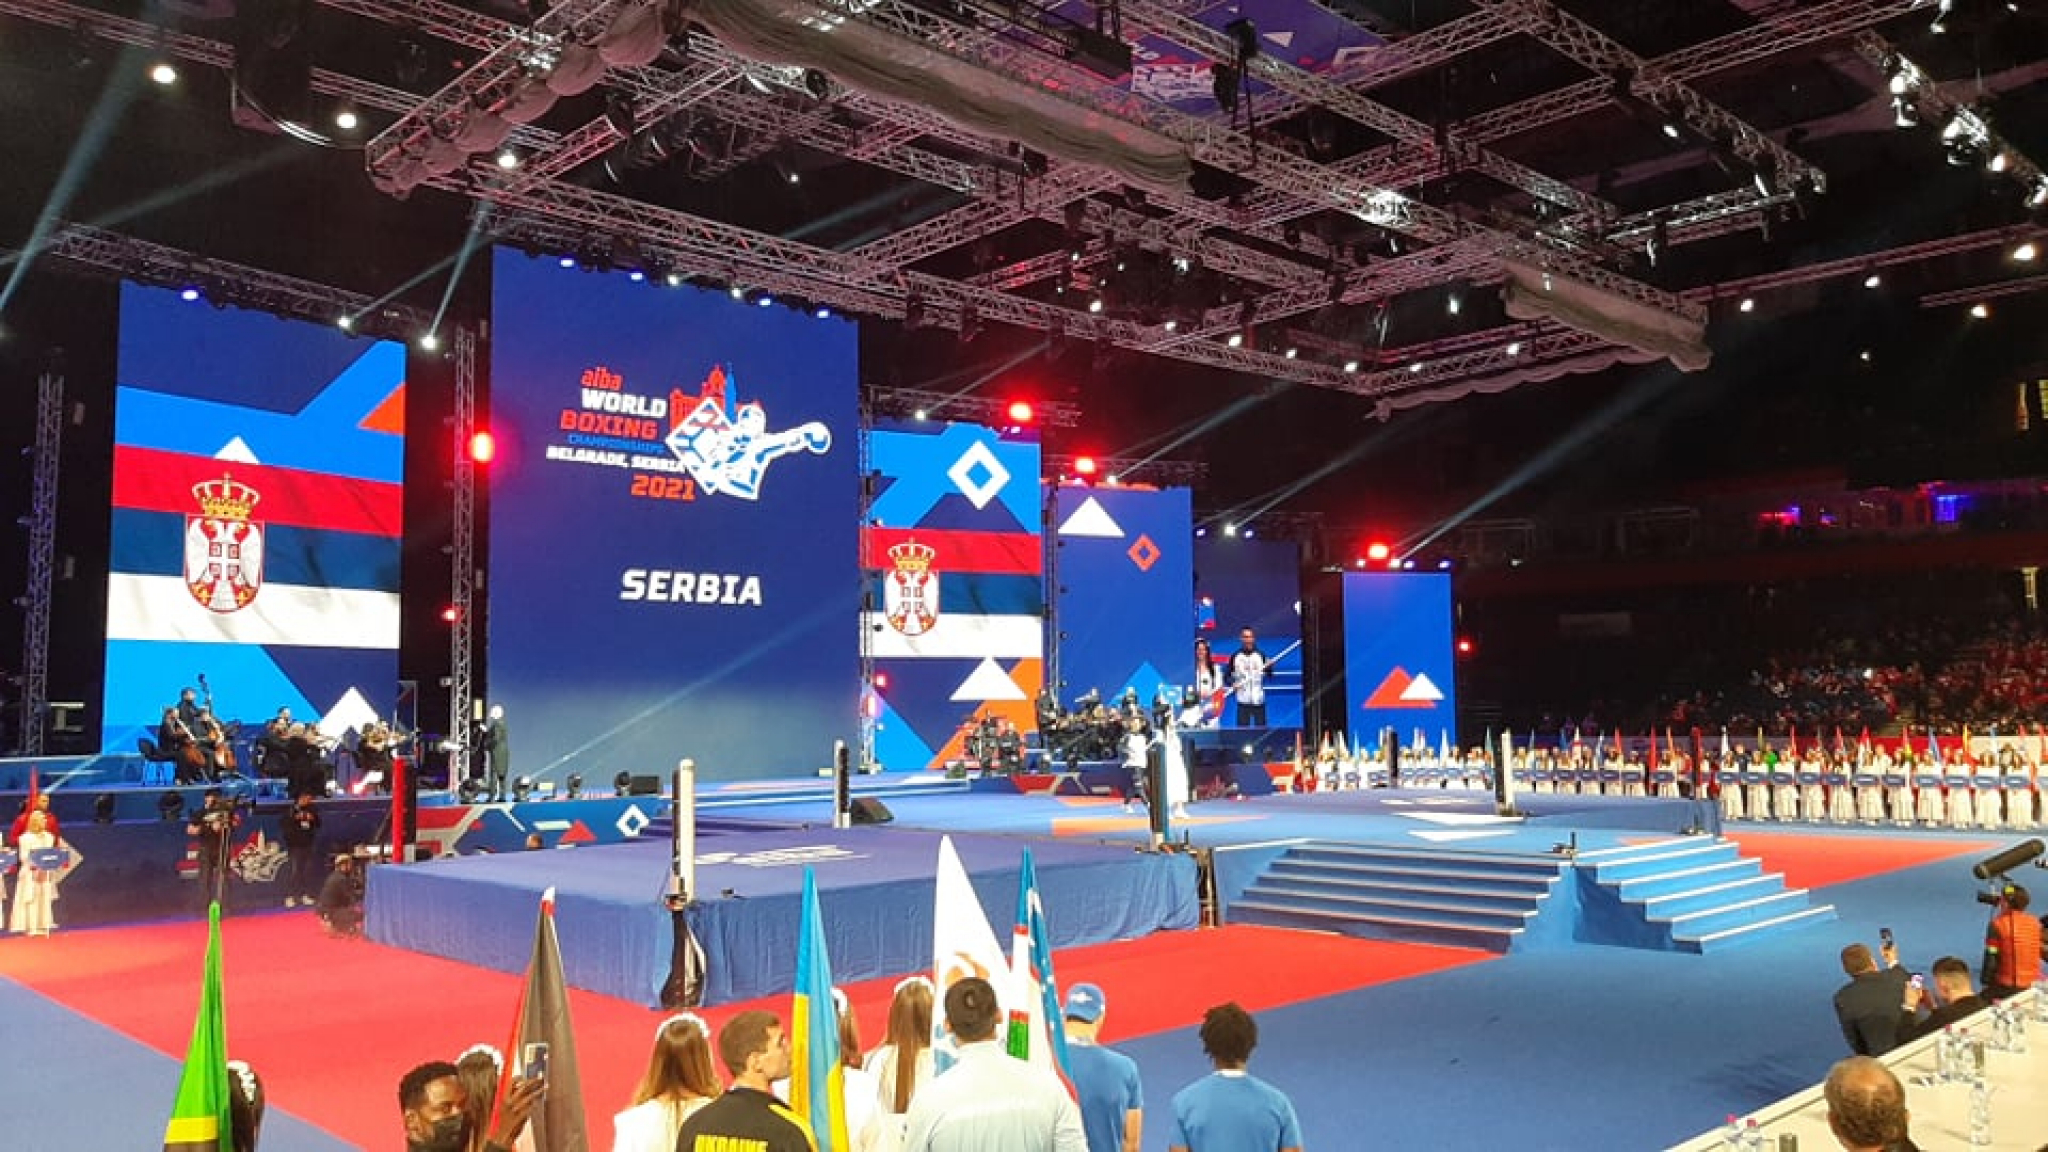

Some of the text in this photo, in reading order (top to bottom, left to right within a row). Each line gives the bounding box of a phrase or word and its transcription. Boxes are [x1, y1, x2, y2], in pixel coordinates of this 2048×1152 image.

[581, 366, 622, 389] aiba
[582, 388, 667, 418] WORLD
[560, 409, 658, 440] BOXING
[631, 473, 696, 501] 2021
[619, 568, 762, 606] SERBIA
